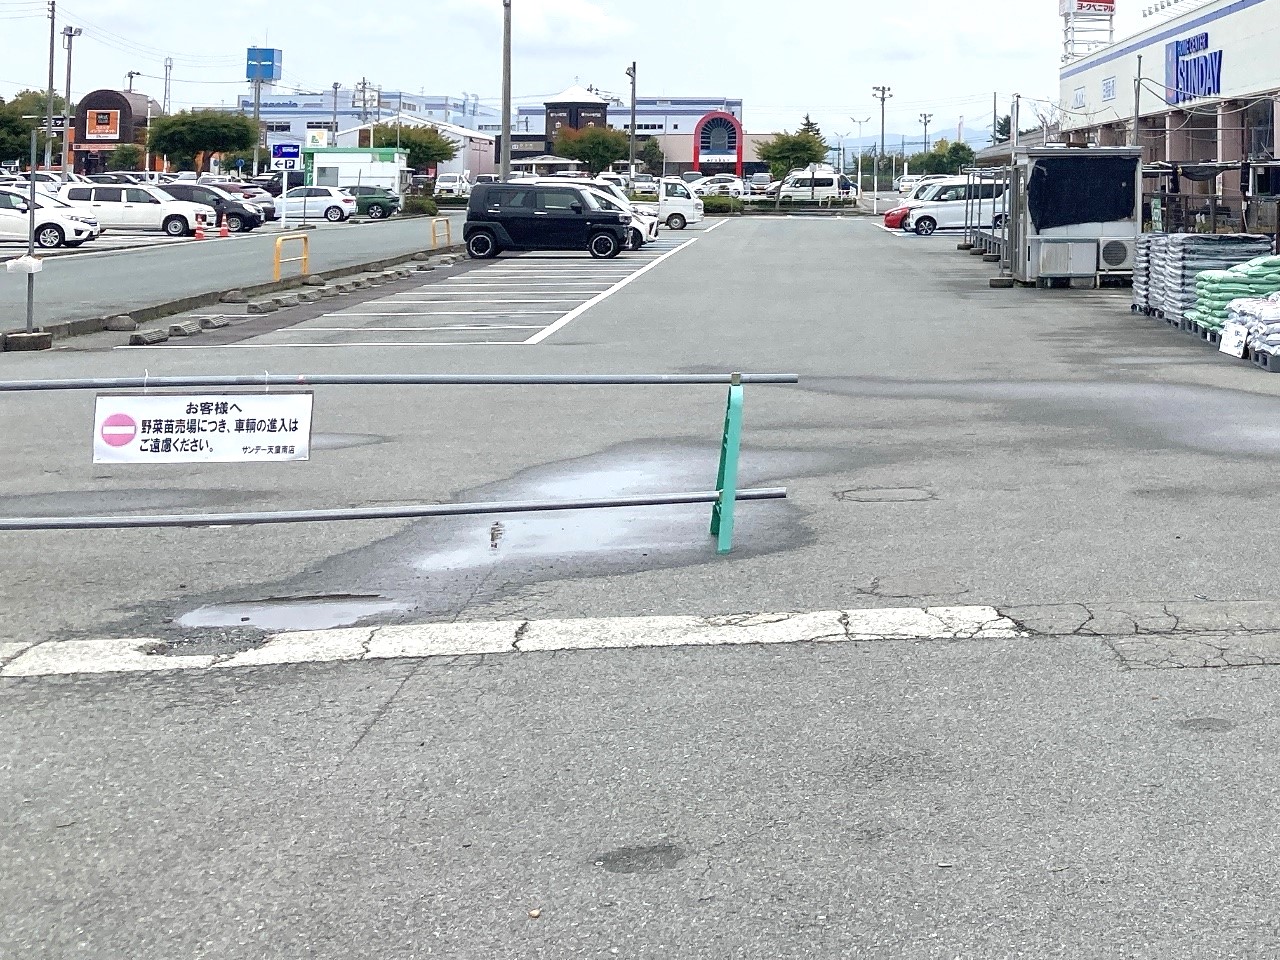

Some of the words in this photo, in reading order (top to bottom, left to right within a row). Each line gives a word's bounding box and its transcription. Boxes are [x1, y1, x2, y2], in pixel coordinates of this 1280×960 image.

[1077, 3, 1115, 12] ヨークベニマル
[1177, 50, 1223, 102] SUNDAY
[286, 160, 294, 168] P
[186, 402, 243, 415] お客様へ
[139, 438, 214, 453] ご遠慮ください。
